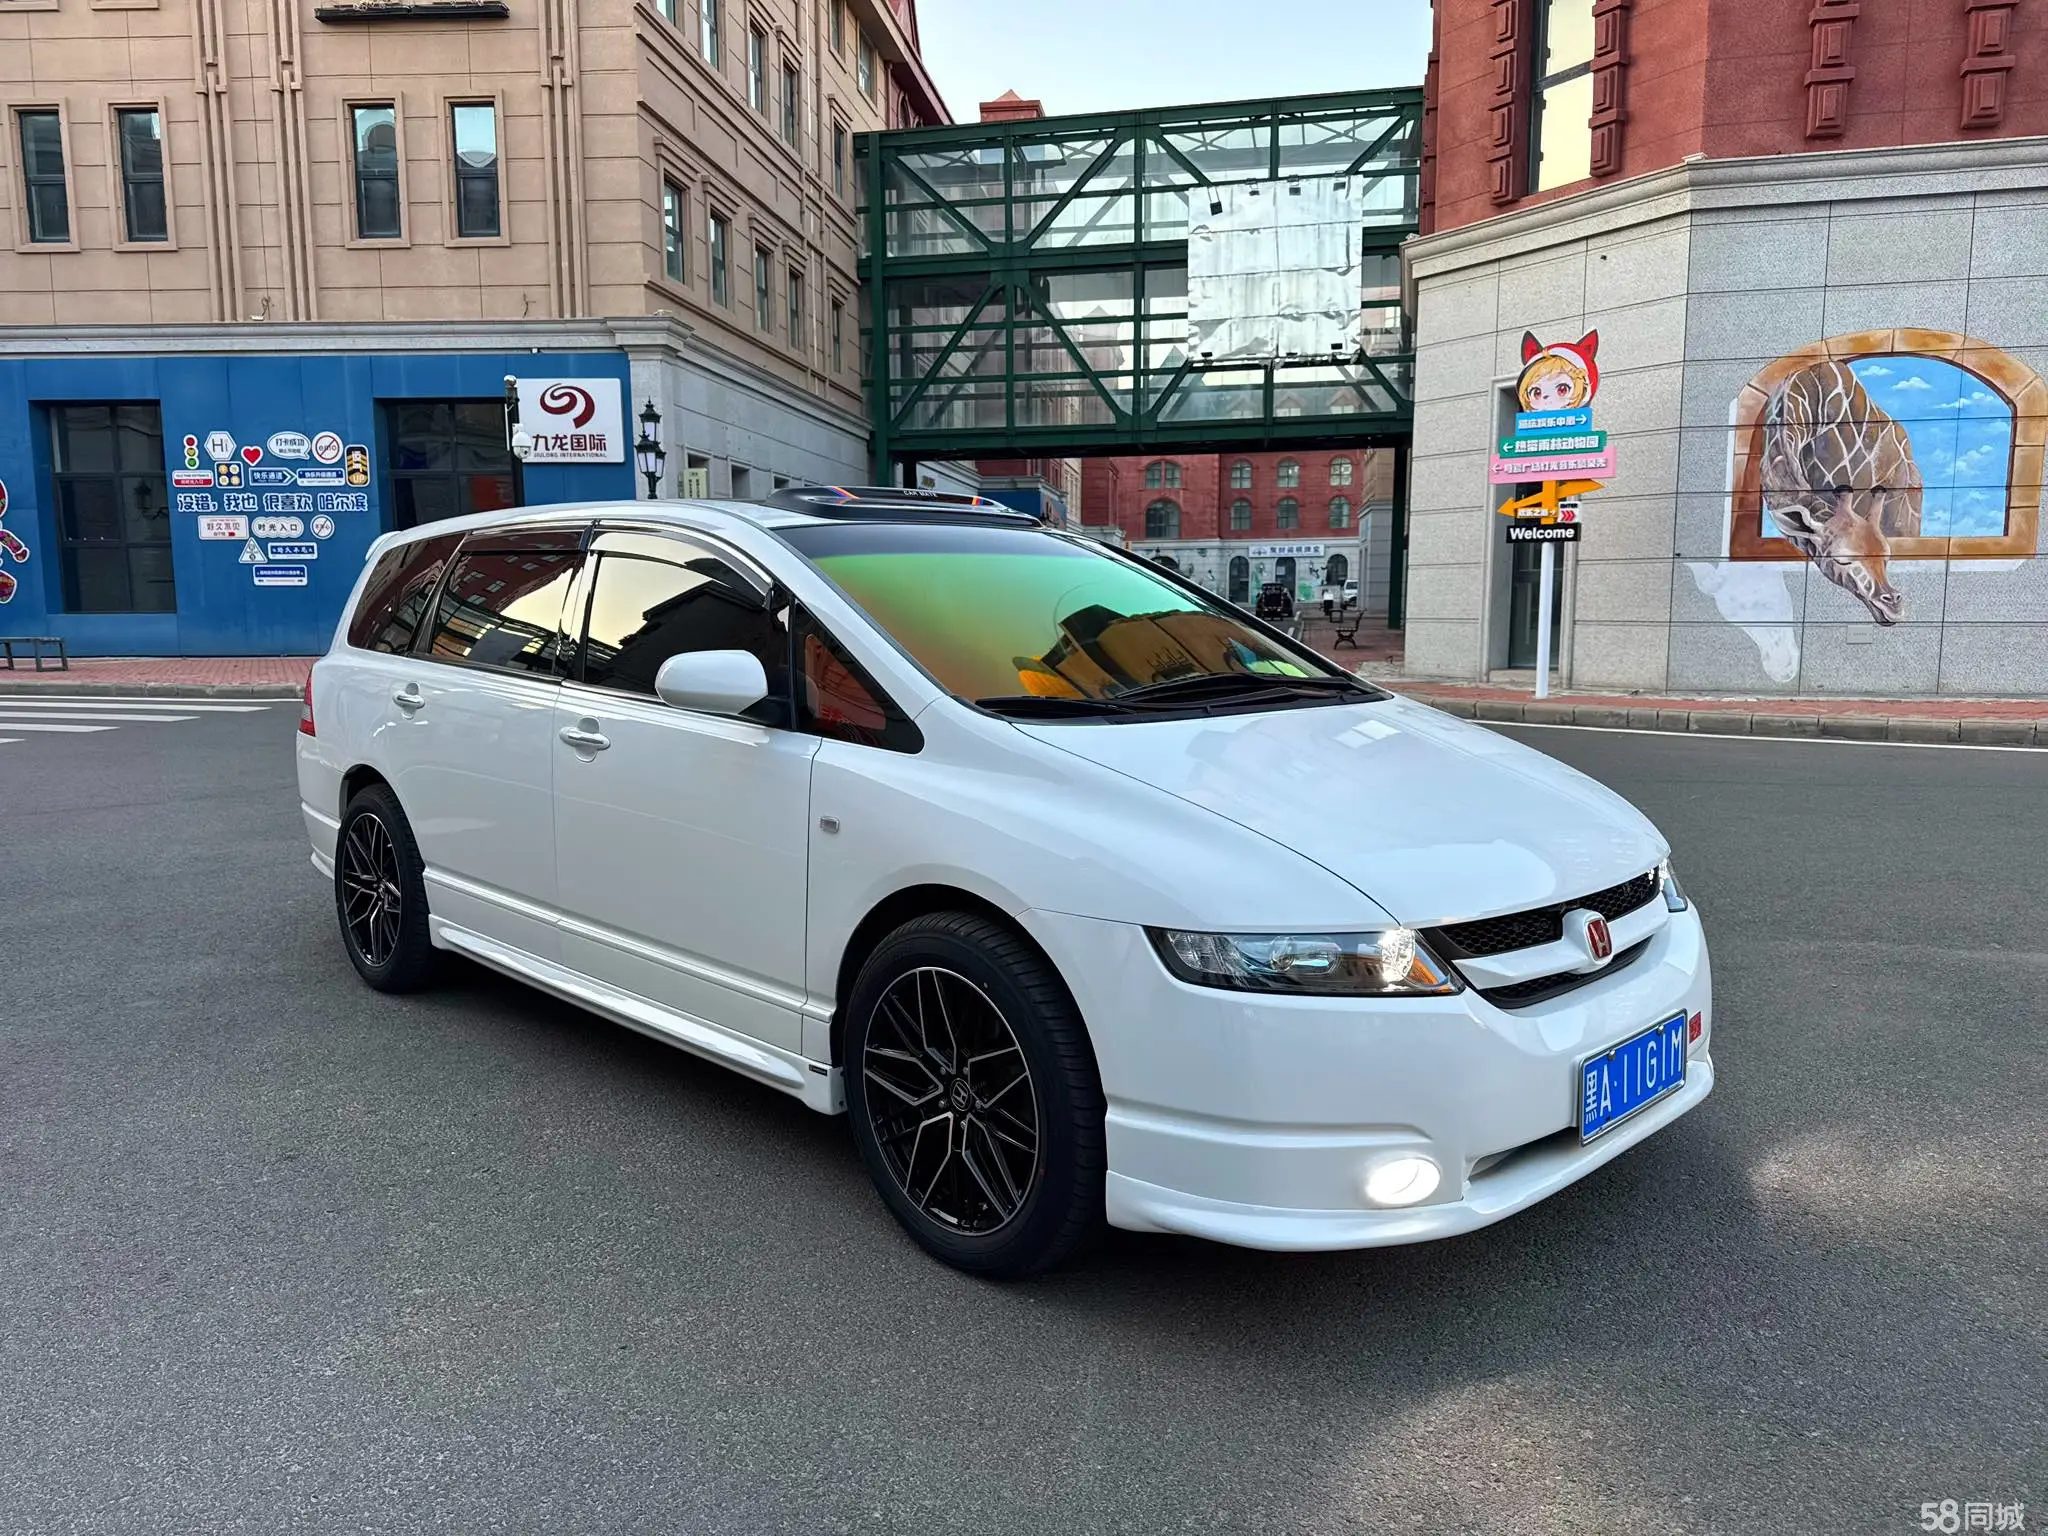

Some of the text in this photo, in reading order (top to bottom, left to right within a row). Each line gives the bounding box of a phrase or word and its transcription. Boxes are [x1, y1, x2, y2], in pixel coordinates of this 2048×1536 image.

[211, 438, 228, 453] Hi
[532, 434, 607, 451] 九龙国际
[224, 493, 258, 512] 我也
[263, 493, 313, 512] 很喜欢
[318, 493, 368, 512] 哈尔滨
[257, 523, 298, 531] 时光入口
[1510, 527, 1575, 540] Welcome
